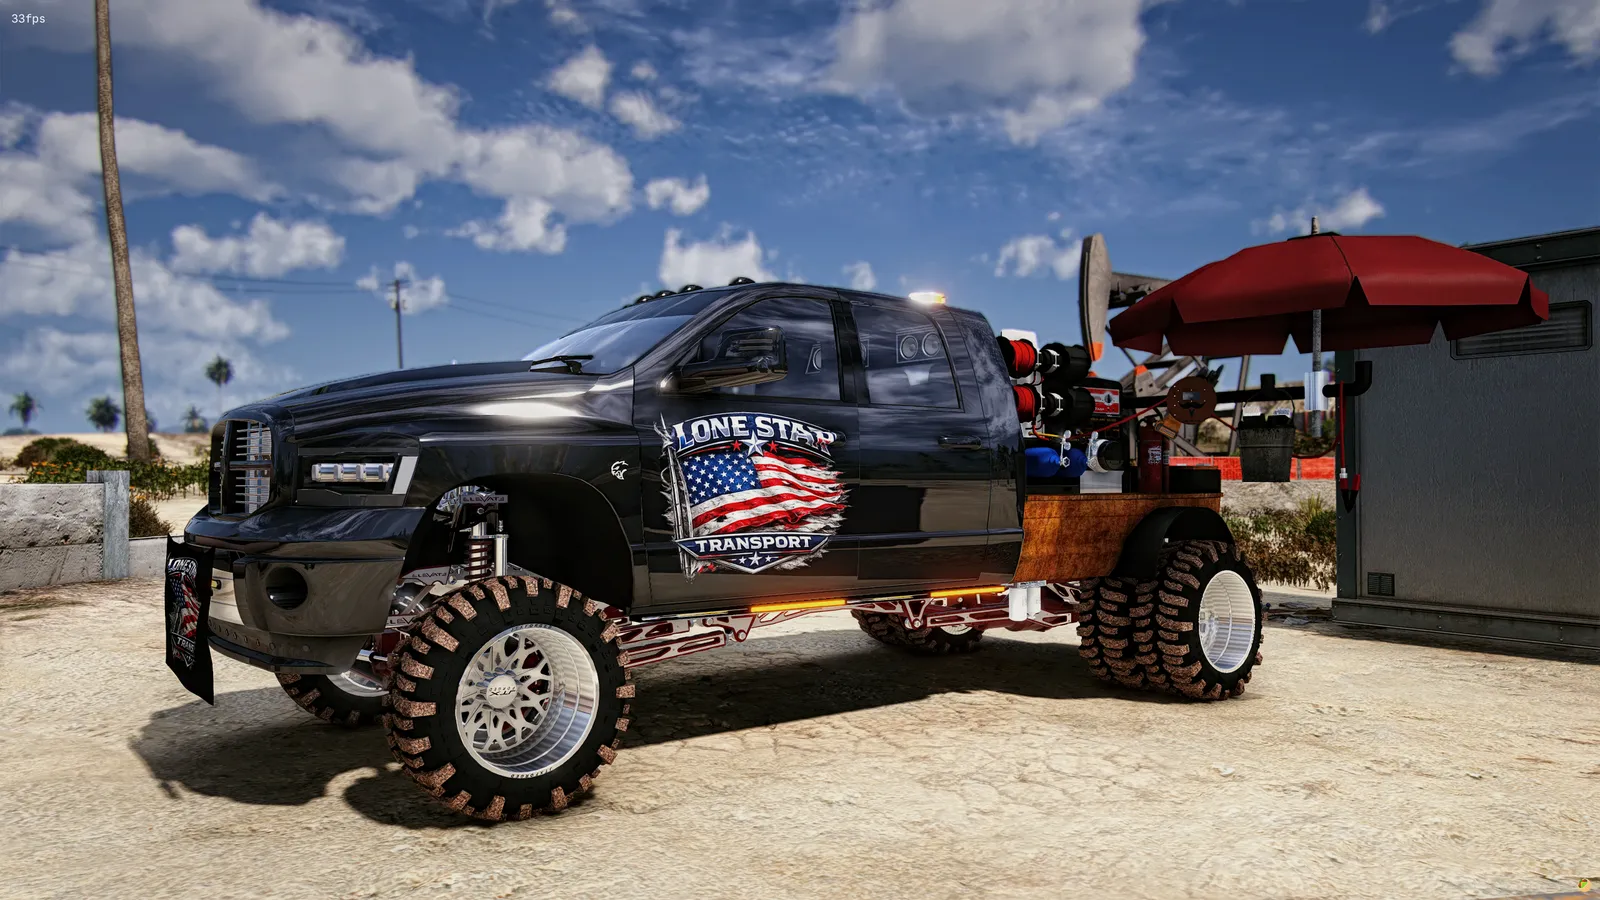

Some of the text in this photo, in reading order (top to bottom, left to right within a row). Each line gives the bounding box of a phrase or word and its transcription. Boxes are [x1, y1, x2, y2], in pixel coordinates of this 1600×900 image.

[672, 416, 836, 456] LONE STAR
[463, 494, 504, 502] ELEVATE
[694, 535, 812, 553] TRANSPORT
[167, 558, 190, 572] LONE
